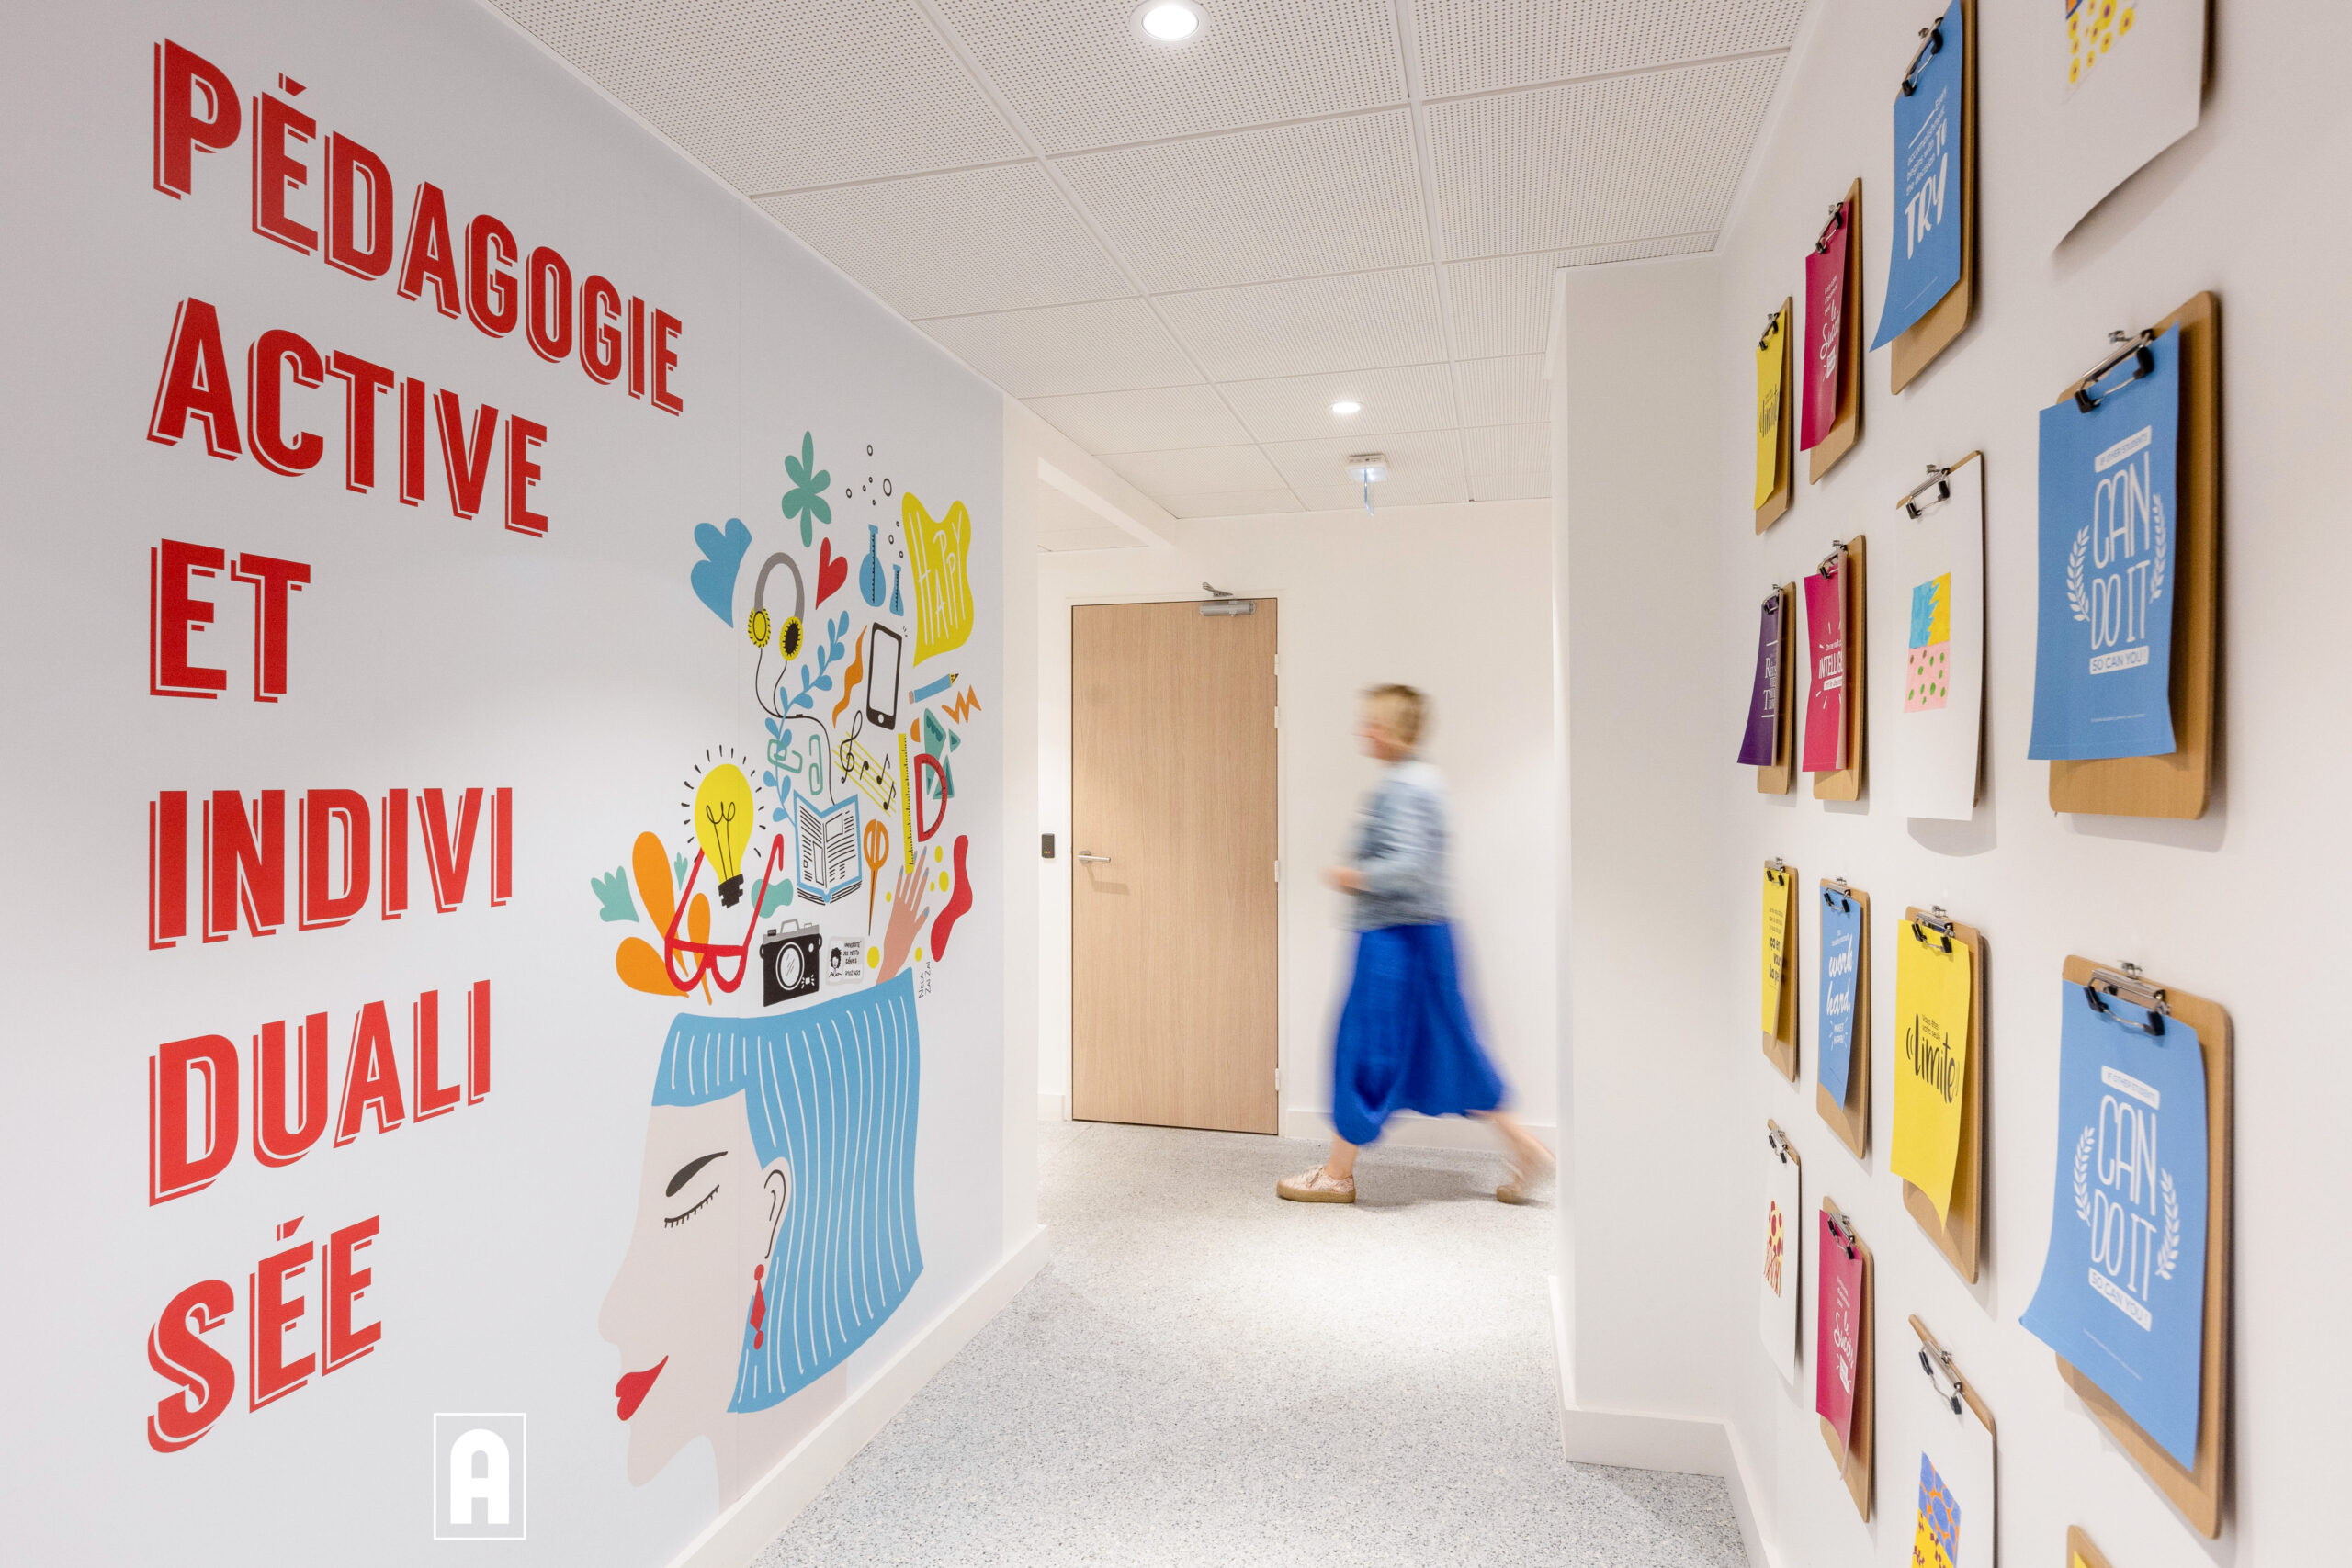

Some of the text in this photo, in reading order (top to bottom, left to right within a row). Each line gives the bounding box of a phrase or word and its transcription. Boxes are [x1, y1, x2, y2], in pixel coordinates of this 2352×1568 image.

[1936, 118, 1947, 157] TO
[154, 39, 683, 415] PÉDAGOGIE
[1905, 152, 1949, 260] TRY
[147, 298, 548, 537] ACTIVE
[2093, 450, 2151, 569] CAN
[150, 539, 311, 703] ET
[908, 509, 967, 646] HAPPY
[2091, 559, 2151, 651] DO IT
[2092, 658, 2104, 671] SO
[2106, 653, 2124, 669] CAN
[149, 788, 512, 950] INDIVI
[1828, 933, 1852, 978] work
[150, 980, 490, 1206] DUALI
[1915, 1013, 1956, 1104] limite
[2098, 1094, 2157, 1217] CAN
[2091, 1188, 2158, 1302] DO IT
[2091, 1271, 2103, 1290] SO
[2104, 1282, 2124, 1305] CAN
[148, 1216, 380, 1452] SÉE
